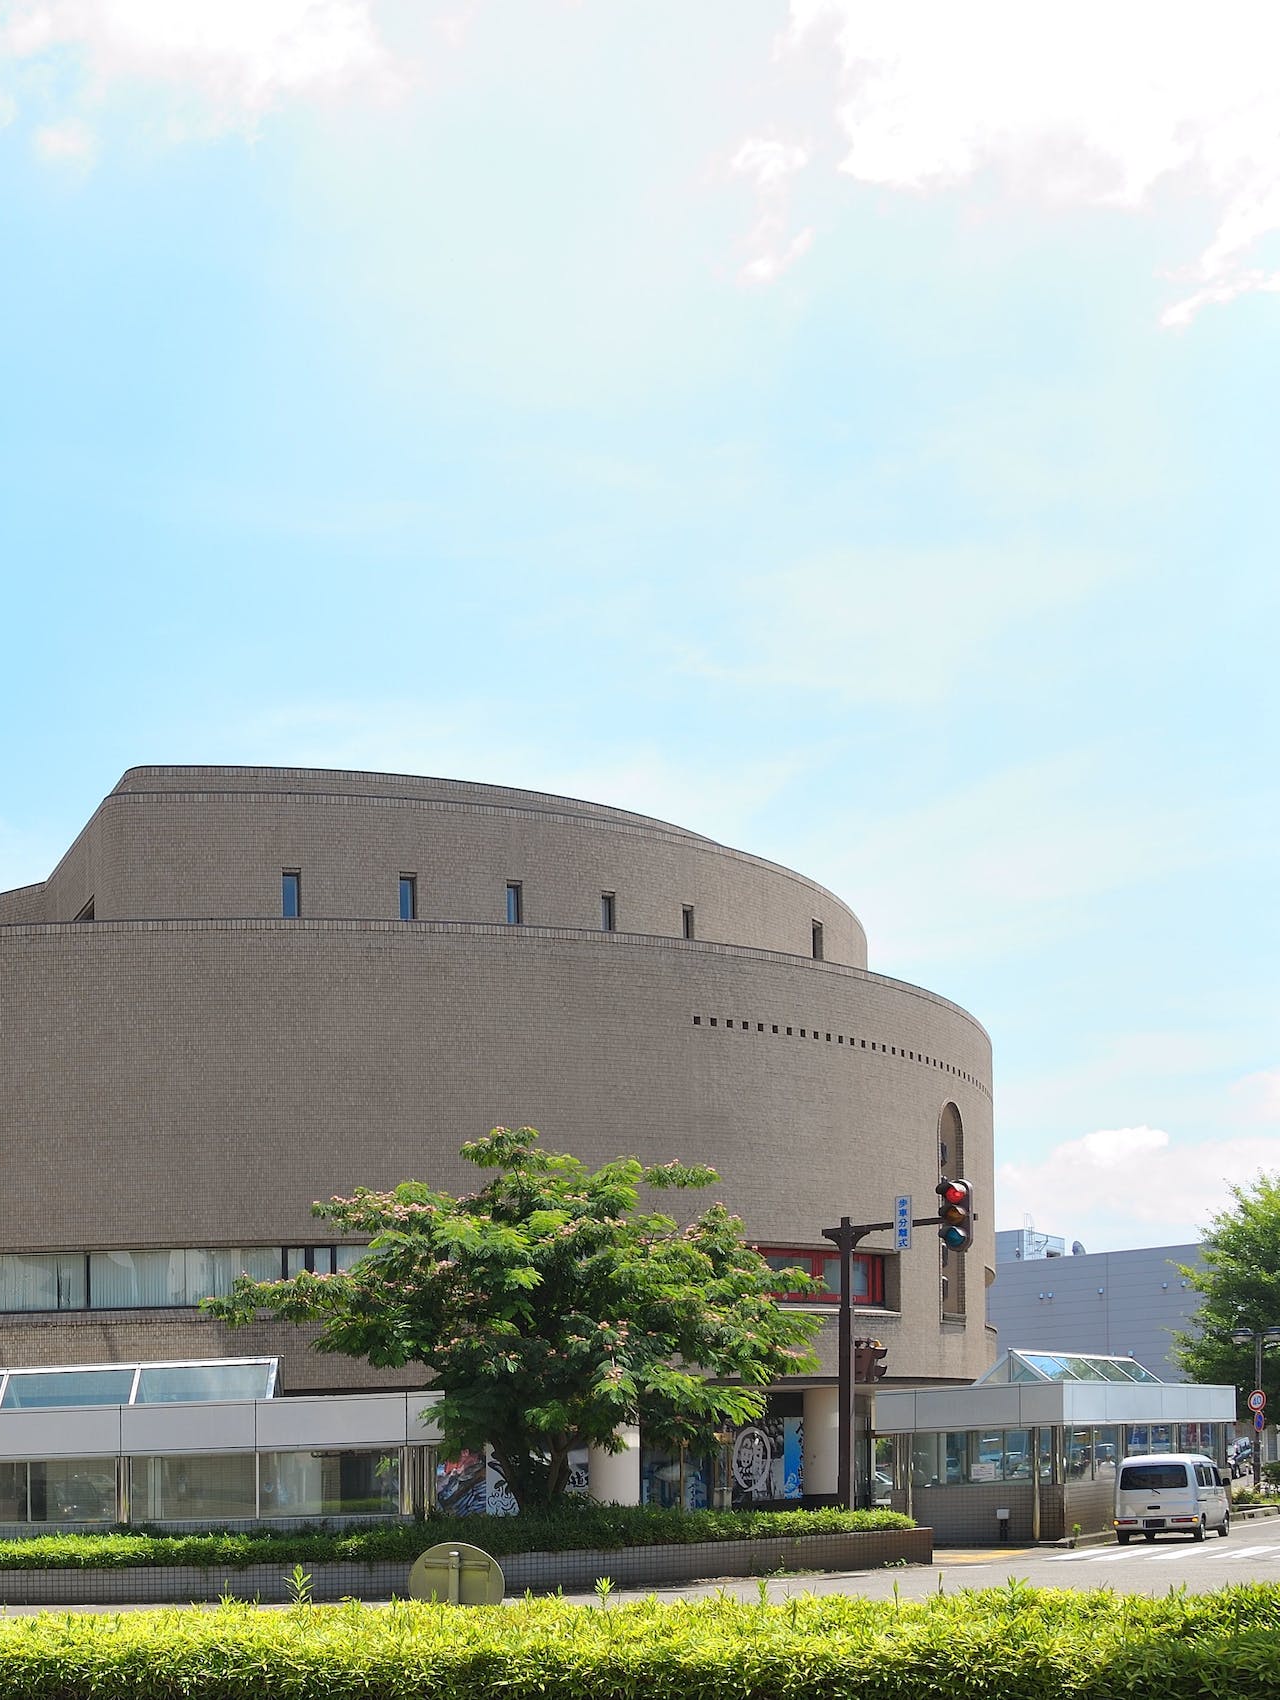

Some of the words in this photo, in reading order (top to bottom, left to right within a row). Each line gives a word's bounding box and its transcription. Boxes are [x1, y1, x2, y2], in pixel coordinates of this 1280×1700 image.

[898, 1198, 908, 1248] 歩車分離式
